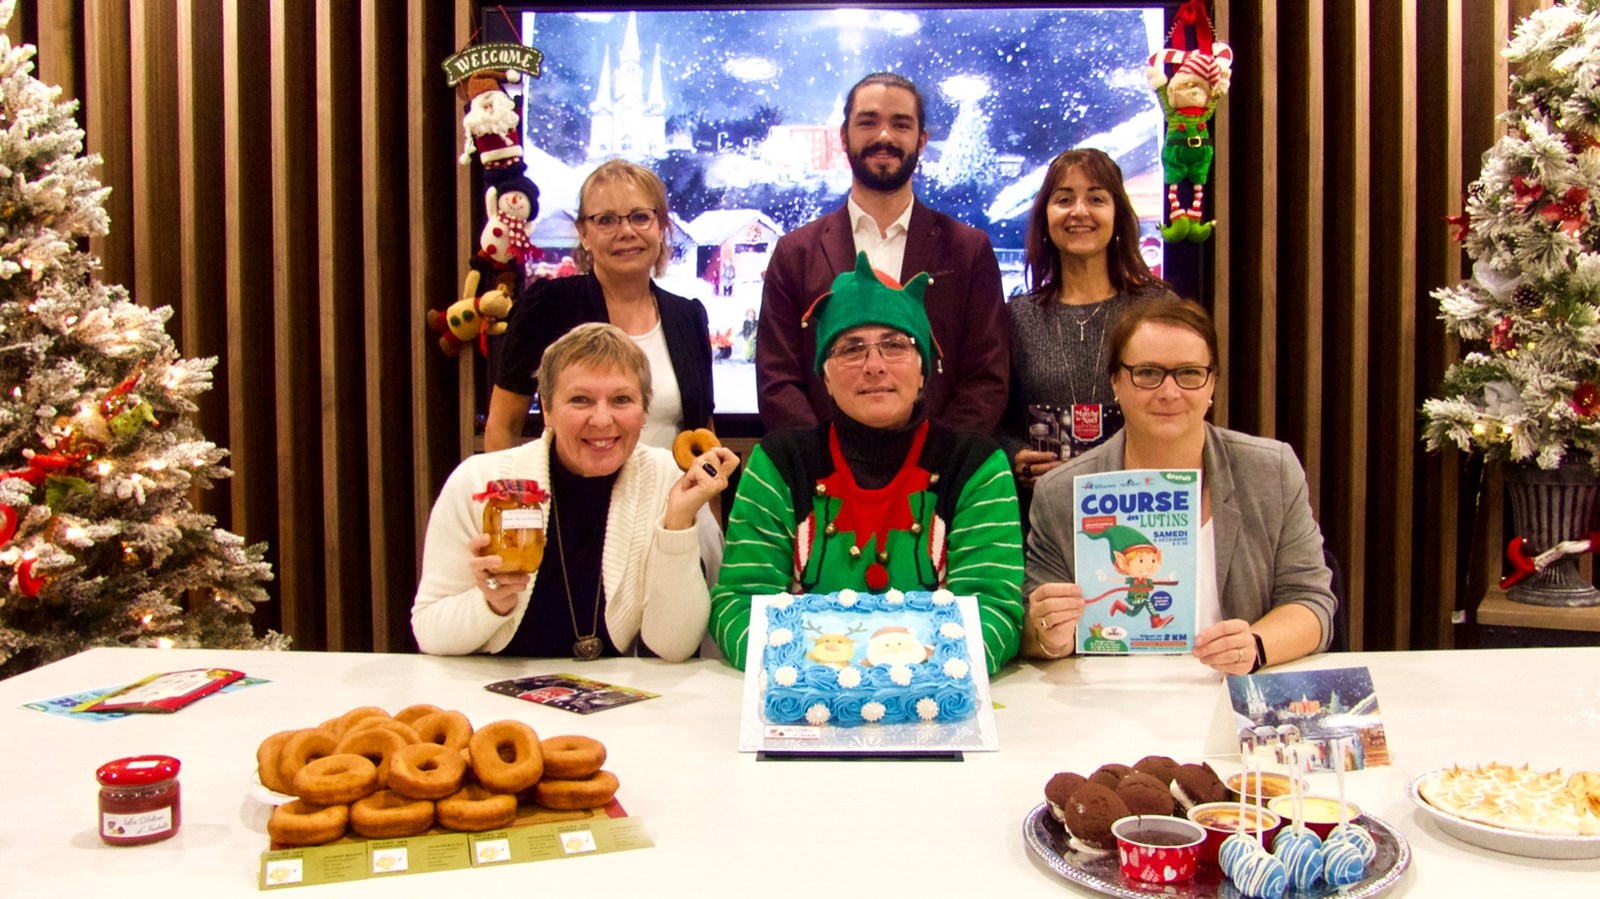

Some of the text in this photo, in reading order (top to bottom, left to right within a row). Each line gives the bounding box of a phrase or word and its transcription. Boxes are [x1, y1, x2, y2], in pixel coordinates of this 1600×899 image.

[454, 49, 533, 74] WELCOME
[1166, 473, 1192, 481] Gratuit
[1081, 491, 1189, 515] COURSE
[1153, 530, 1188, 538] SAMEDI
[1163, 633, 1187, 641] 2 KM
